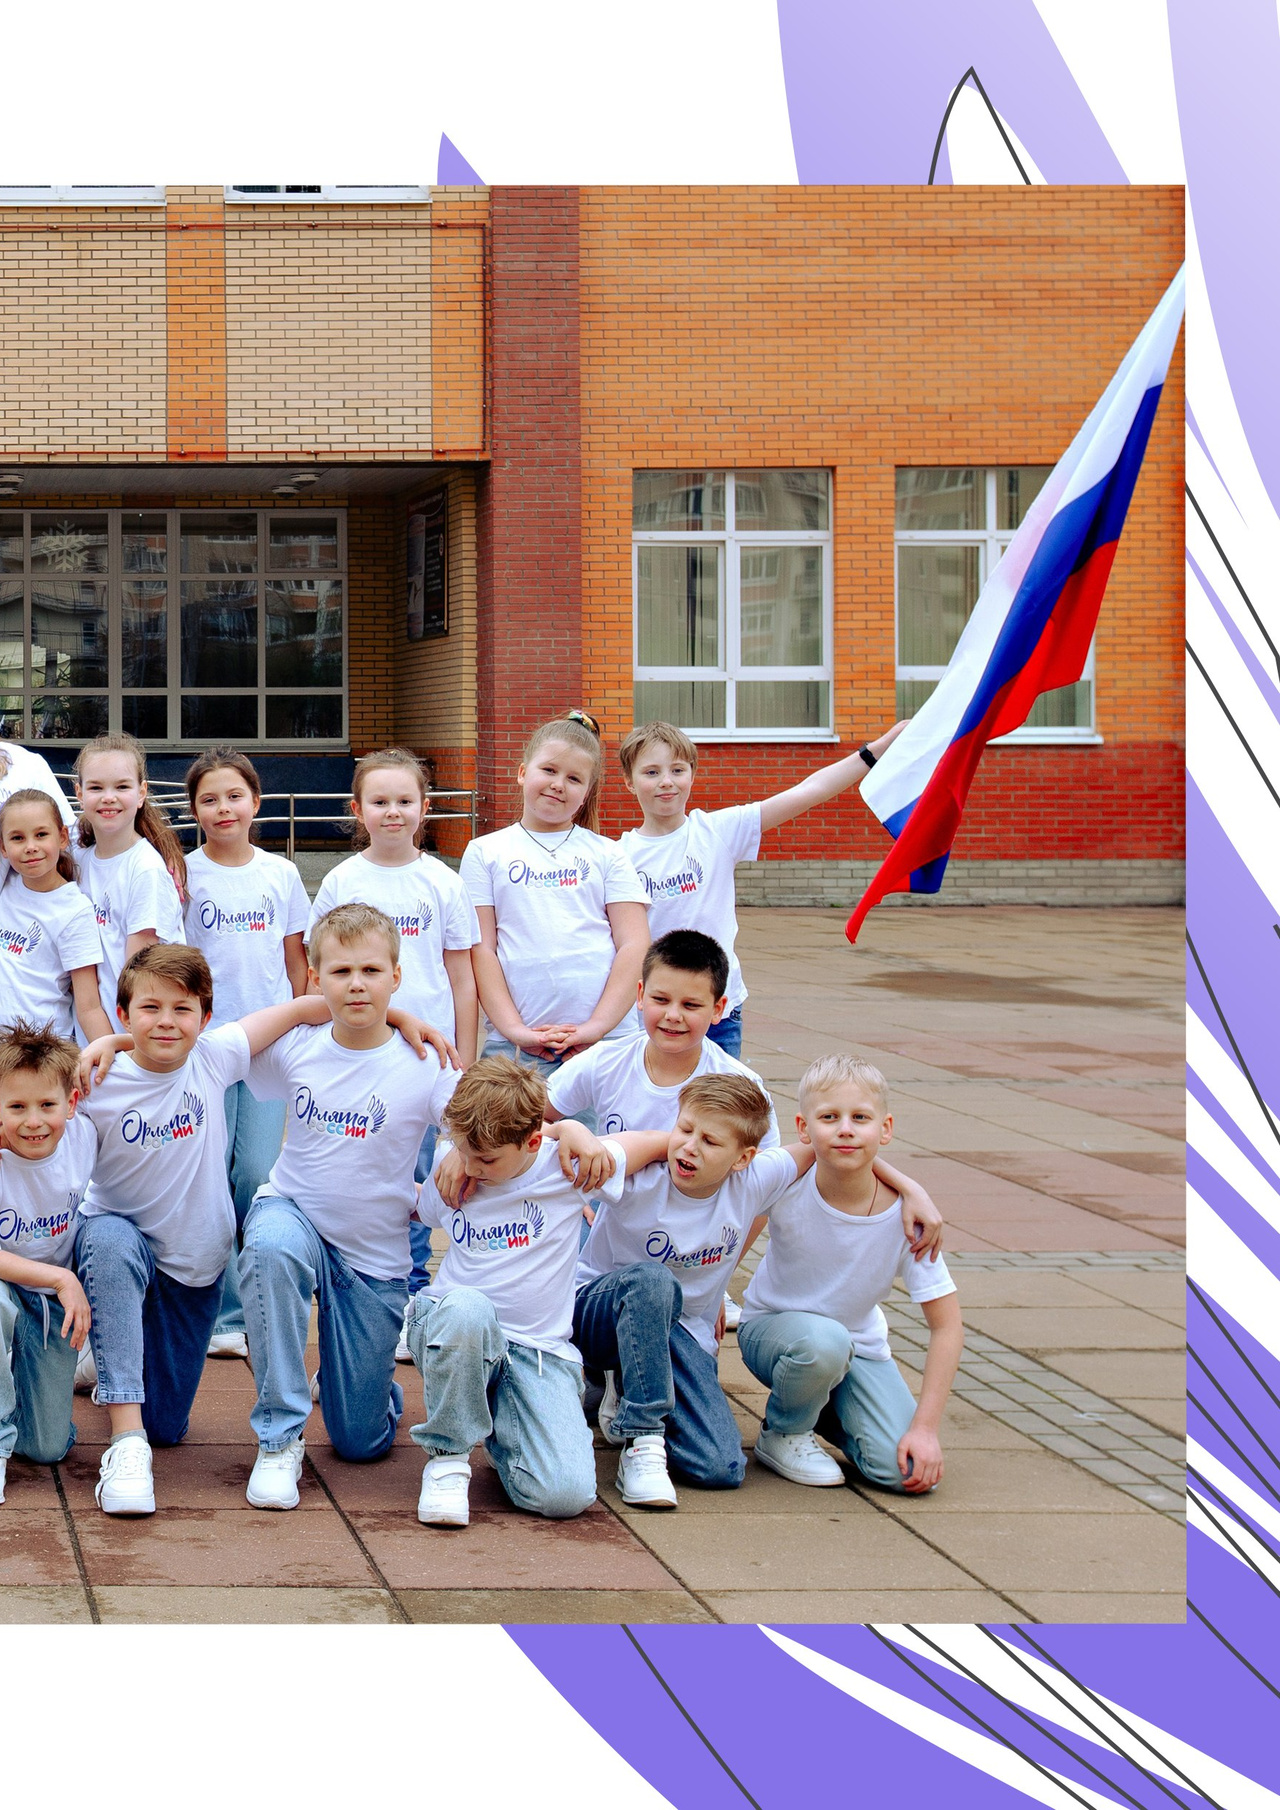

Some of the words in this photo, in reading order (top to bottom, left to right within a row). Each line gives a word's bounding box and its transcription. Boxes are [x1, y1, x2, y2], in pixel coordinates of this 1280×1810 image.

[507, 859, 578, 886] Орлята
[199, 899, 265, 931] Орлята
[295, 1086, 369, 1128] Орлята
[307, 1119, 367, 1139] РОССИИ
[451, 1208, 528, 1248] Орлята
[646, 1230, 724, 1264] Орлята
